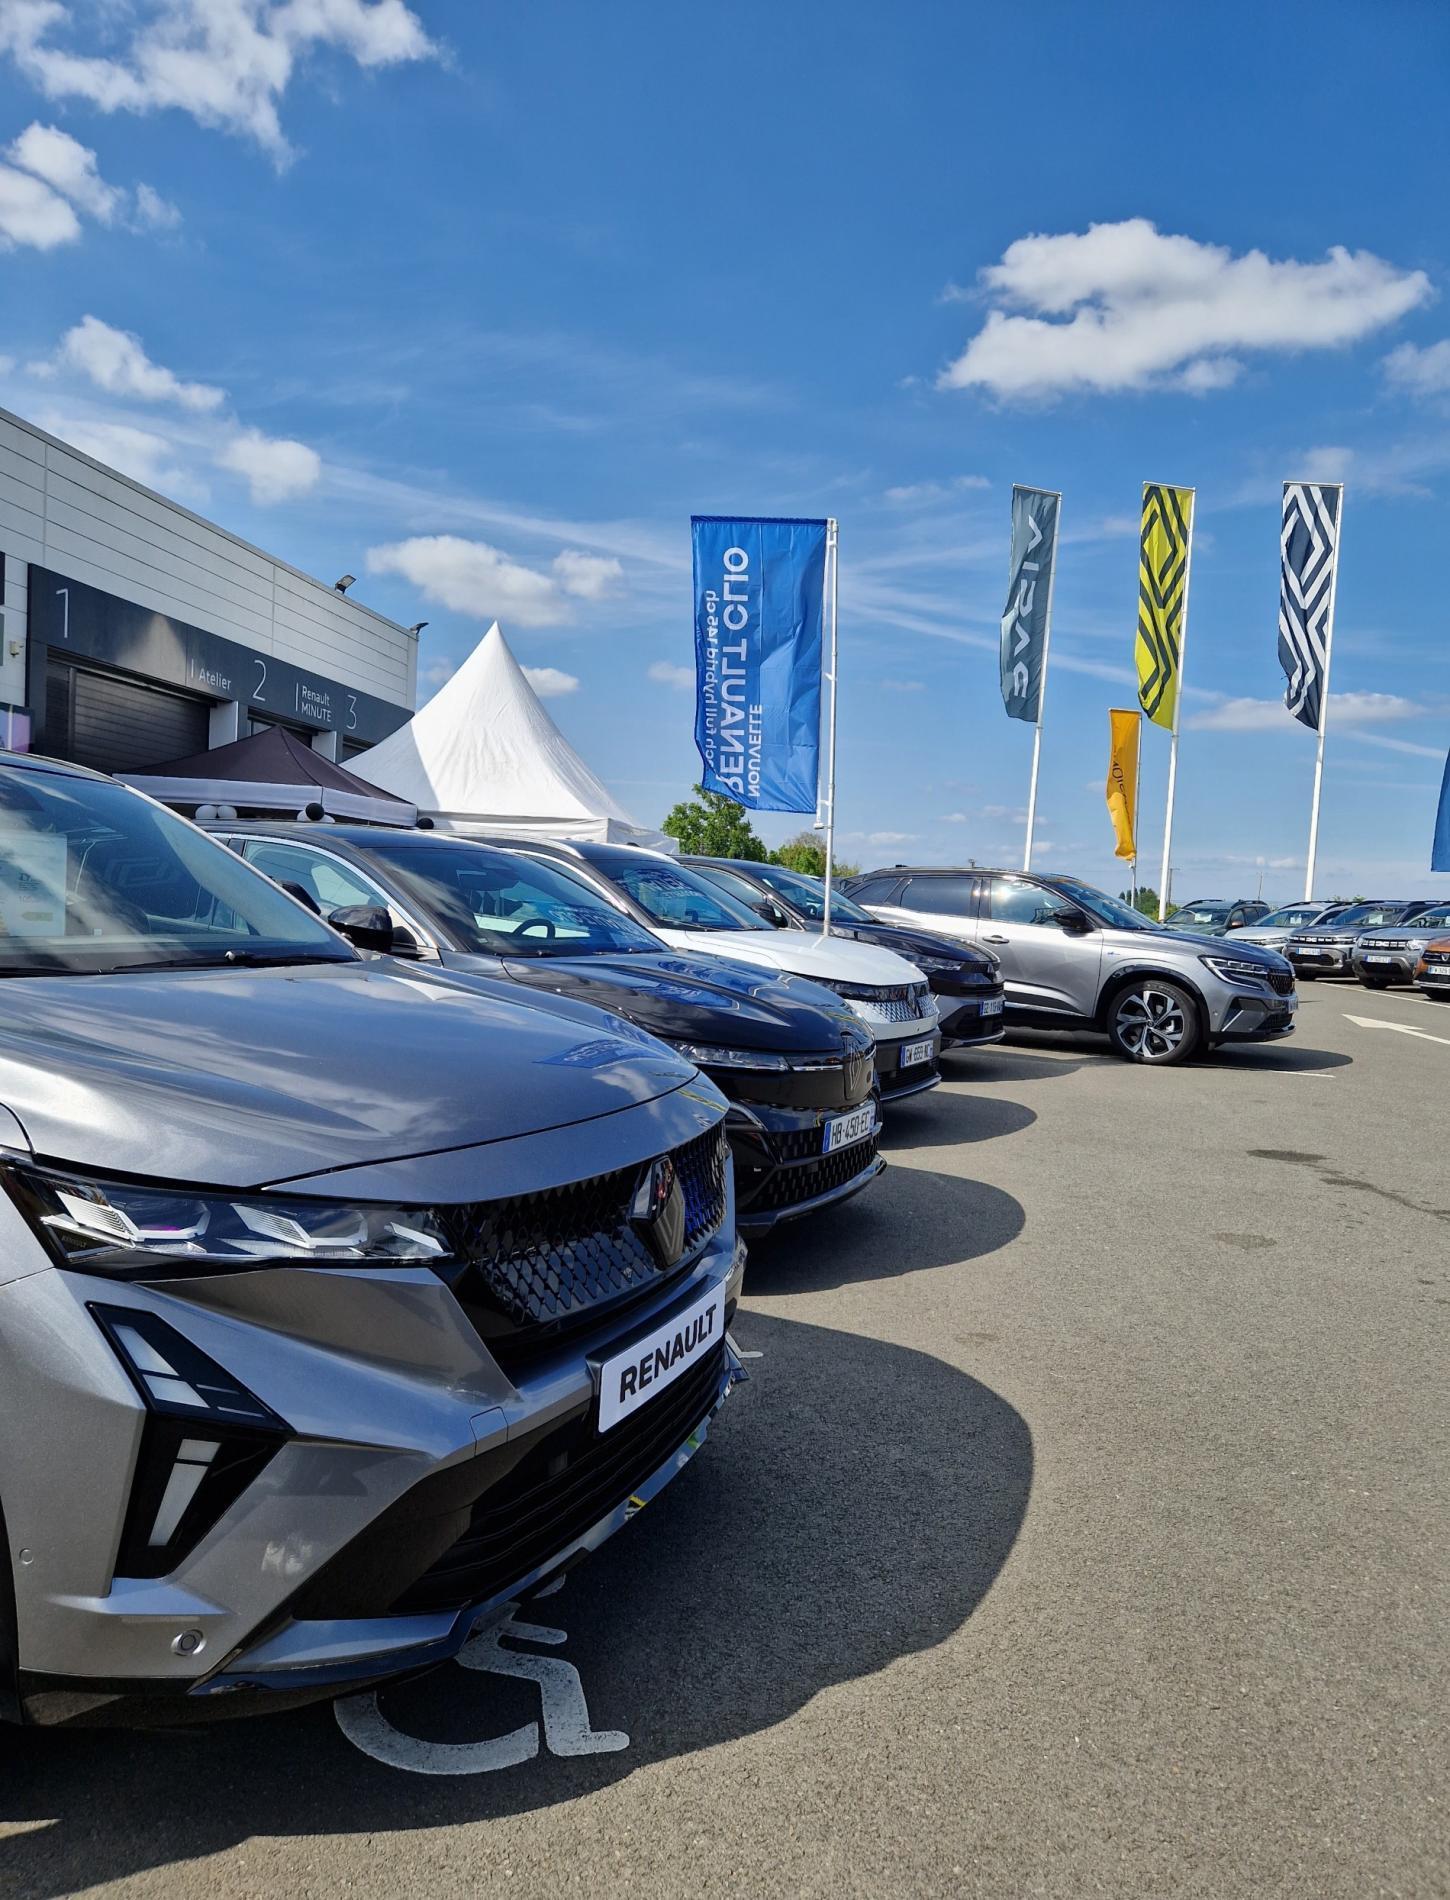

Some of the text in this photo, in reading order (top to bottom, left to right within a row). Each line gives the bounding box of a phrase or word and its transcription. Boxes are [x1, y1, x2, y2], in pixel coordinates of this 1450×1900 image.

[55, 588, 69, 639] 1
[198, 667, 232, 692] Atelier
[252, 659, 267, 702] 2
[302, 685, 330, 707] Renault
[301, 702, 332, 723] MINUTE
[346, 694, 357, 730] 3
[619, 1303, 717, 1404] RENAULT
